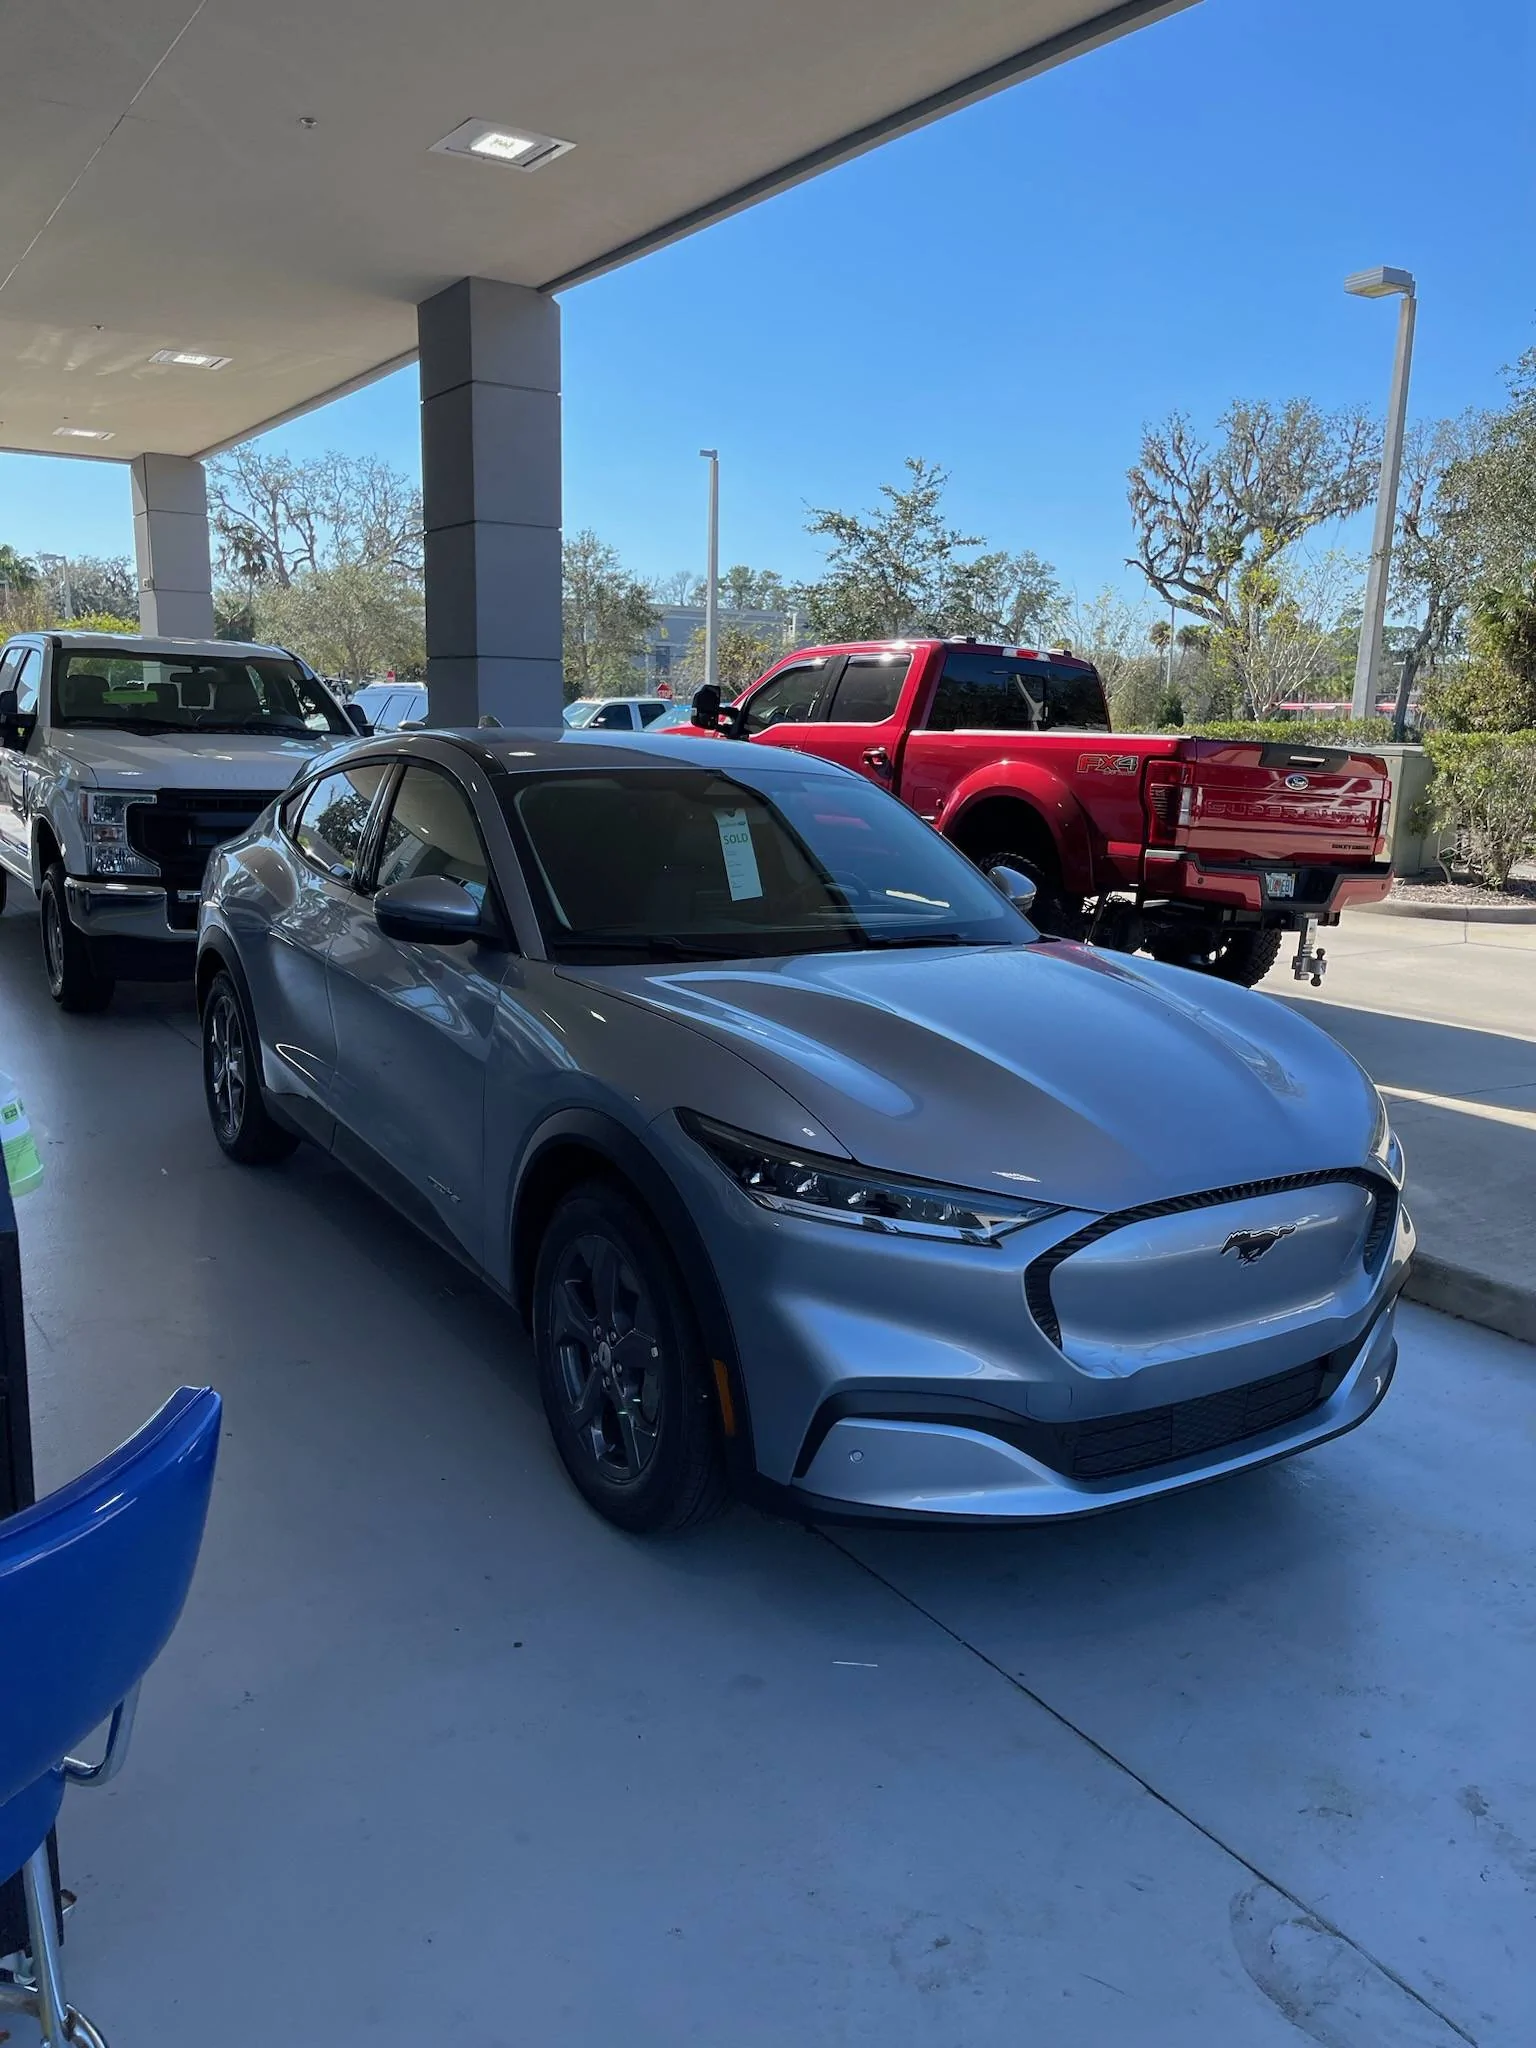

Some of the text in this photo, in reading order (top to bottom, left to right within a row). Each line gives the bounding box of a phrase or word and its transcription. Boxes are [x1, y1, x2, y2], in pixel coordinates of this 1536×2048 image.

[1077, 753, 1139, 773] FX4
[1206, 800, 1299, 819] SUPER
[723, 833, 749, 845] SOLD
